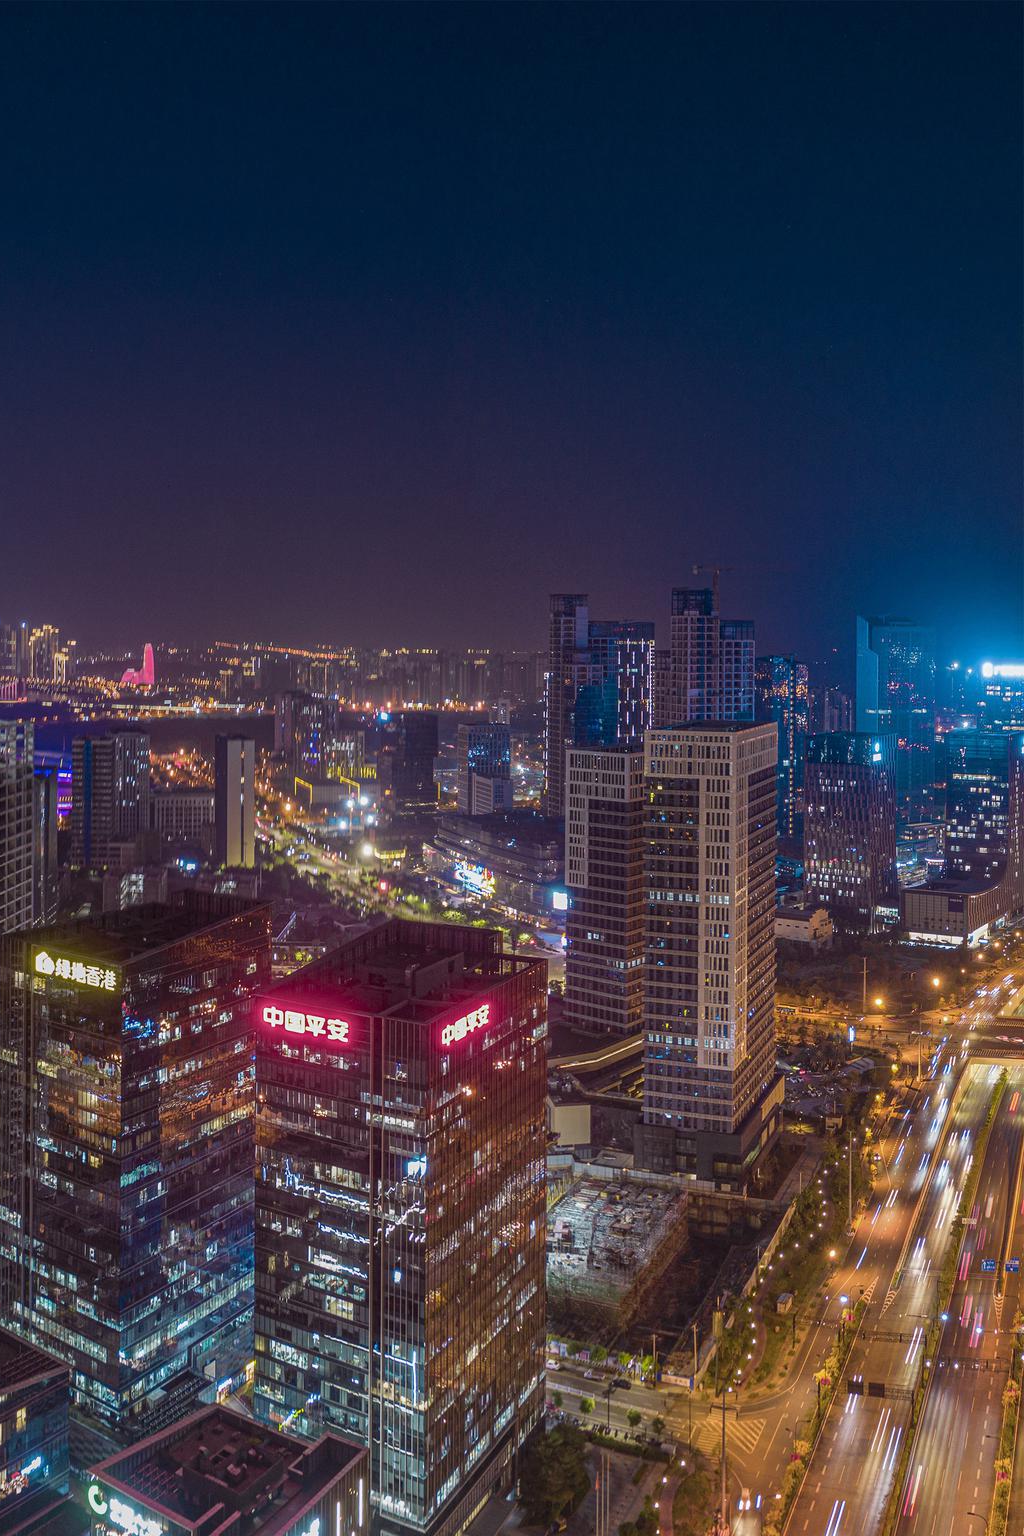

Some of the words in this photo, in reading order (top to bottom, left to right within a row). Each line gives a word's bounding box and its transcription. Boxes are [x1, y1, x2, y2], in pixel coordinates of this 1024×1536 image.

[55, 957, 117, 991] 绿地香港
[263, 1006, 349, 1043] 中国平安
